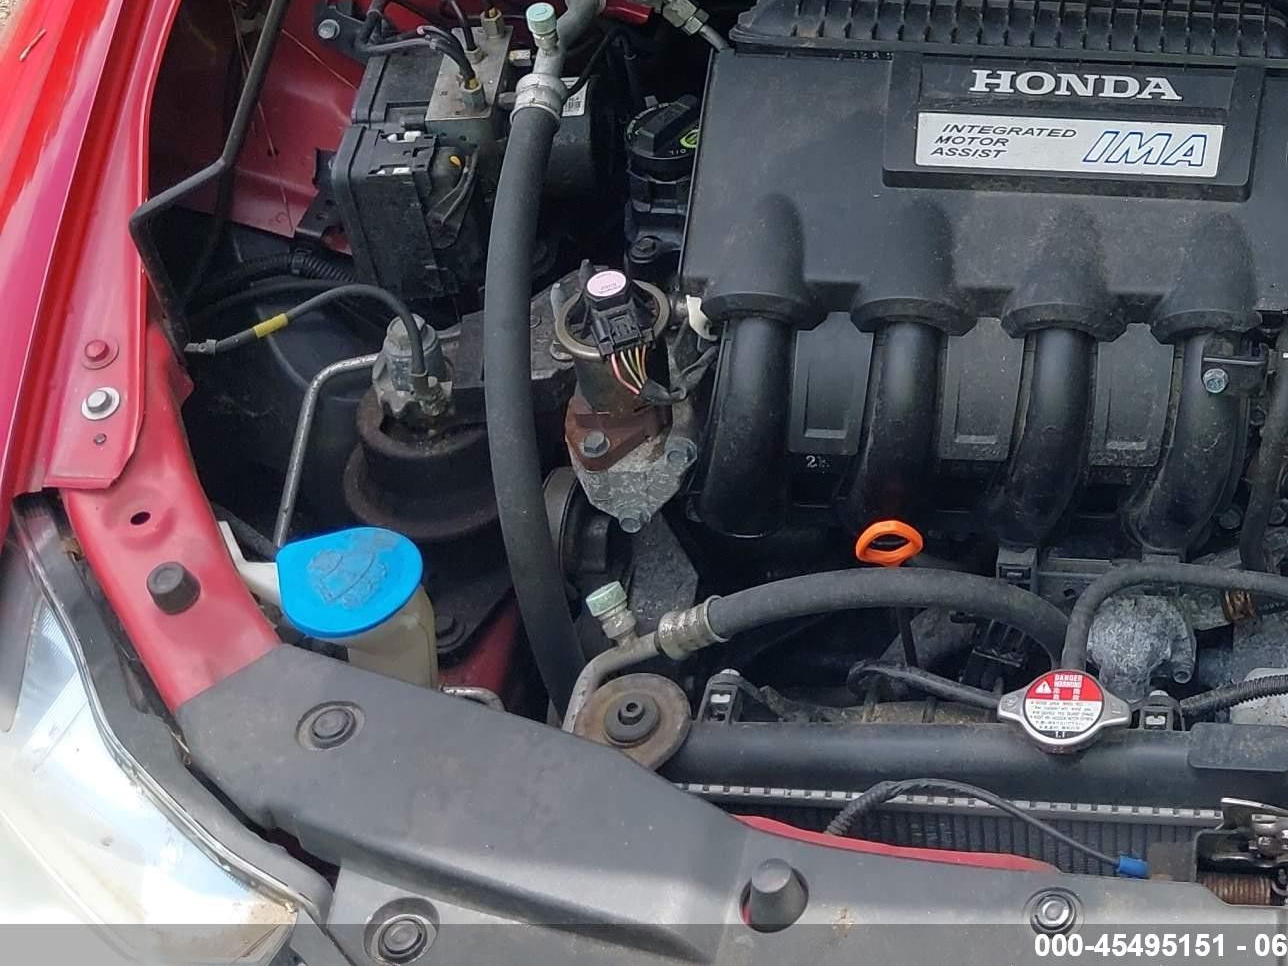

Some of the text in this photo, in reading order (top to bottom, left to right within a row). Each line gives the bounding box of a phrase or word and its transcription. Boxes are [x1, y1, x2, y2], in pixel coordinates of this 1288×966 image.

[969, 69, 1183, 101] HONDA
[941, 123, 1077, 139] INTEGRATED
[933, 135, 1009, 147] MOTOR
[1082, 130, 1208, 167] IMA
[929, 146, 1008, 159] ASSIST
